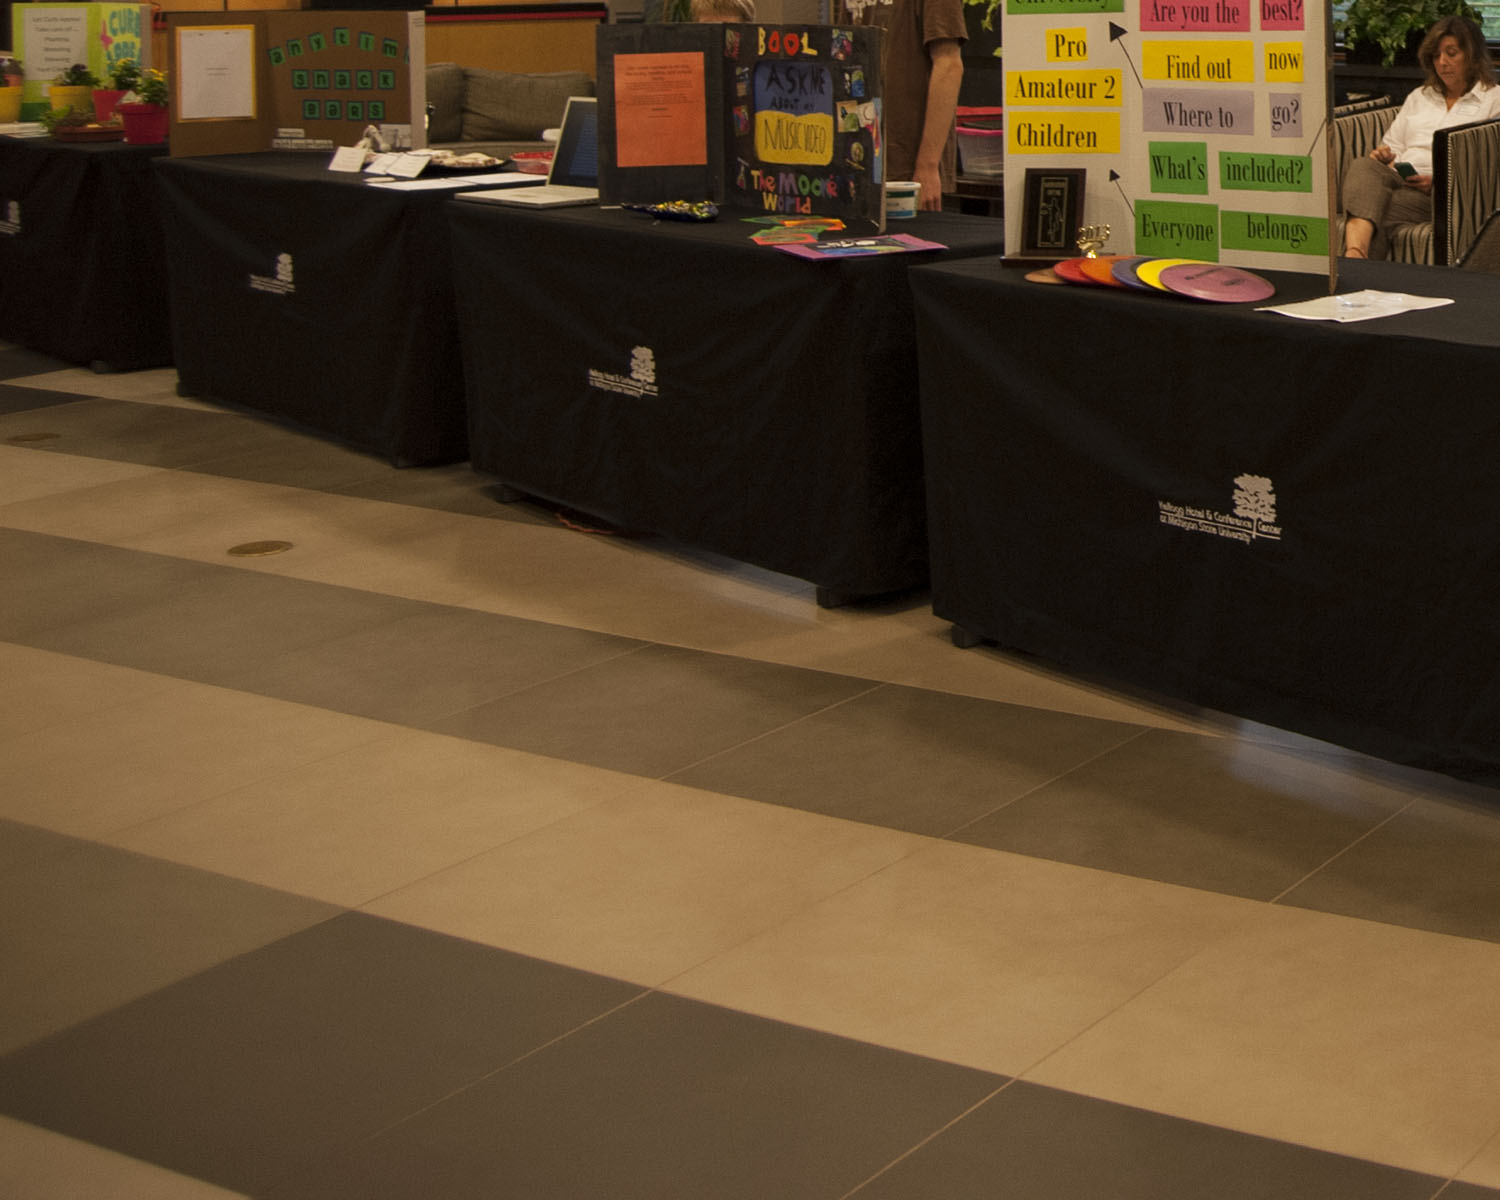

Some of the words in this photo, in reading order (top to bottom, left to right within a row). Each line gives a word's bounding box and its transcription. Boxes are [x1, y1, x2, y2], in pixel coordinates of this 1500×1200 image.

[1150, 0, 1176, 22] Are
[1182, 6, 1209, 29] you
[1216, 0, 1240, 24] the
[1055, 34, 1087, 58] Pro
[766, 64, 808, 95] ASK
[810, 64, 825, 95] ME
[1166, 54, 1200, 79] Find
[1207, 58, 1231, 80] out
[1269, 52, 1299, 70] now
[1014, 74, 1097, 99] Amateur
[1104, 75, 1115, 99] 2
[1163, 102, 1213, 127] Where
[1219, 107, 1233, 128] to
[1271, 99, 1299, 131] go?
[764, 119, 802, 151] MUSIC
[803, 123, 826, 154] VIDEO
[1017, 122, 1097, 148] Children
[751, 169, 776, 192] The
[1152, 155, 1205, 180] What's
[1226, 157, 1303, 185] included?
[762, 192, 812, 214] World
[1142, 214, 1214, 246] Everyone
[1247, 214, 1308, 249] belongs
